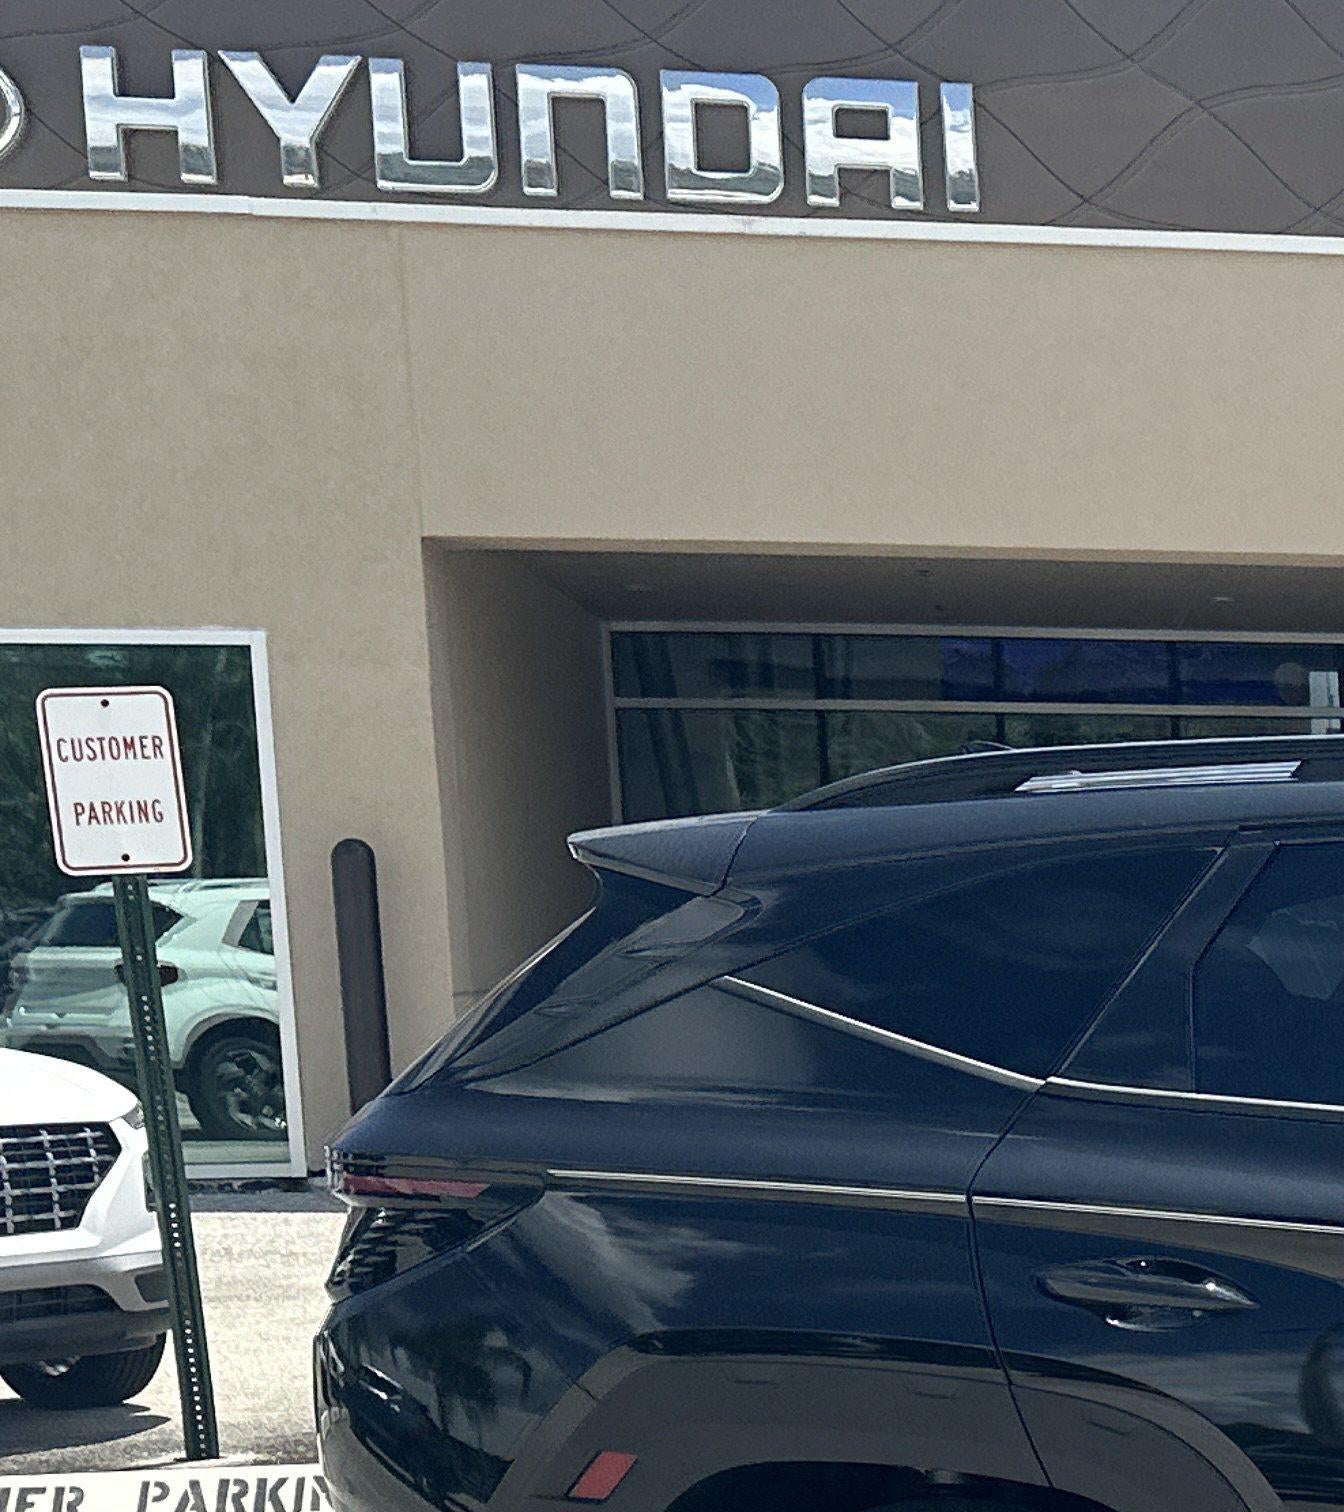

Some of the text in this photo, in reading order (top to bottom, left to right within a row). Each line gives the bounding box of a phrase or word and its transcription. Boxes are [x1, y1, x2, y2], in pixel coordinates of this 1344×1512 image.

[79, 44, 982, 213] HYUNDAI
[56, 735, 165, 763] CUSTOMER
[73, 799, 165, 827] PARKING
